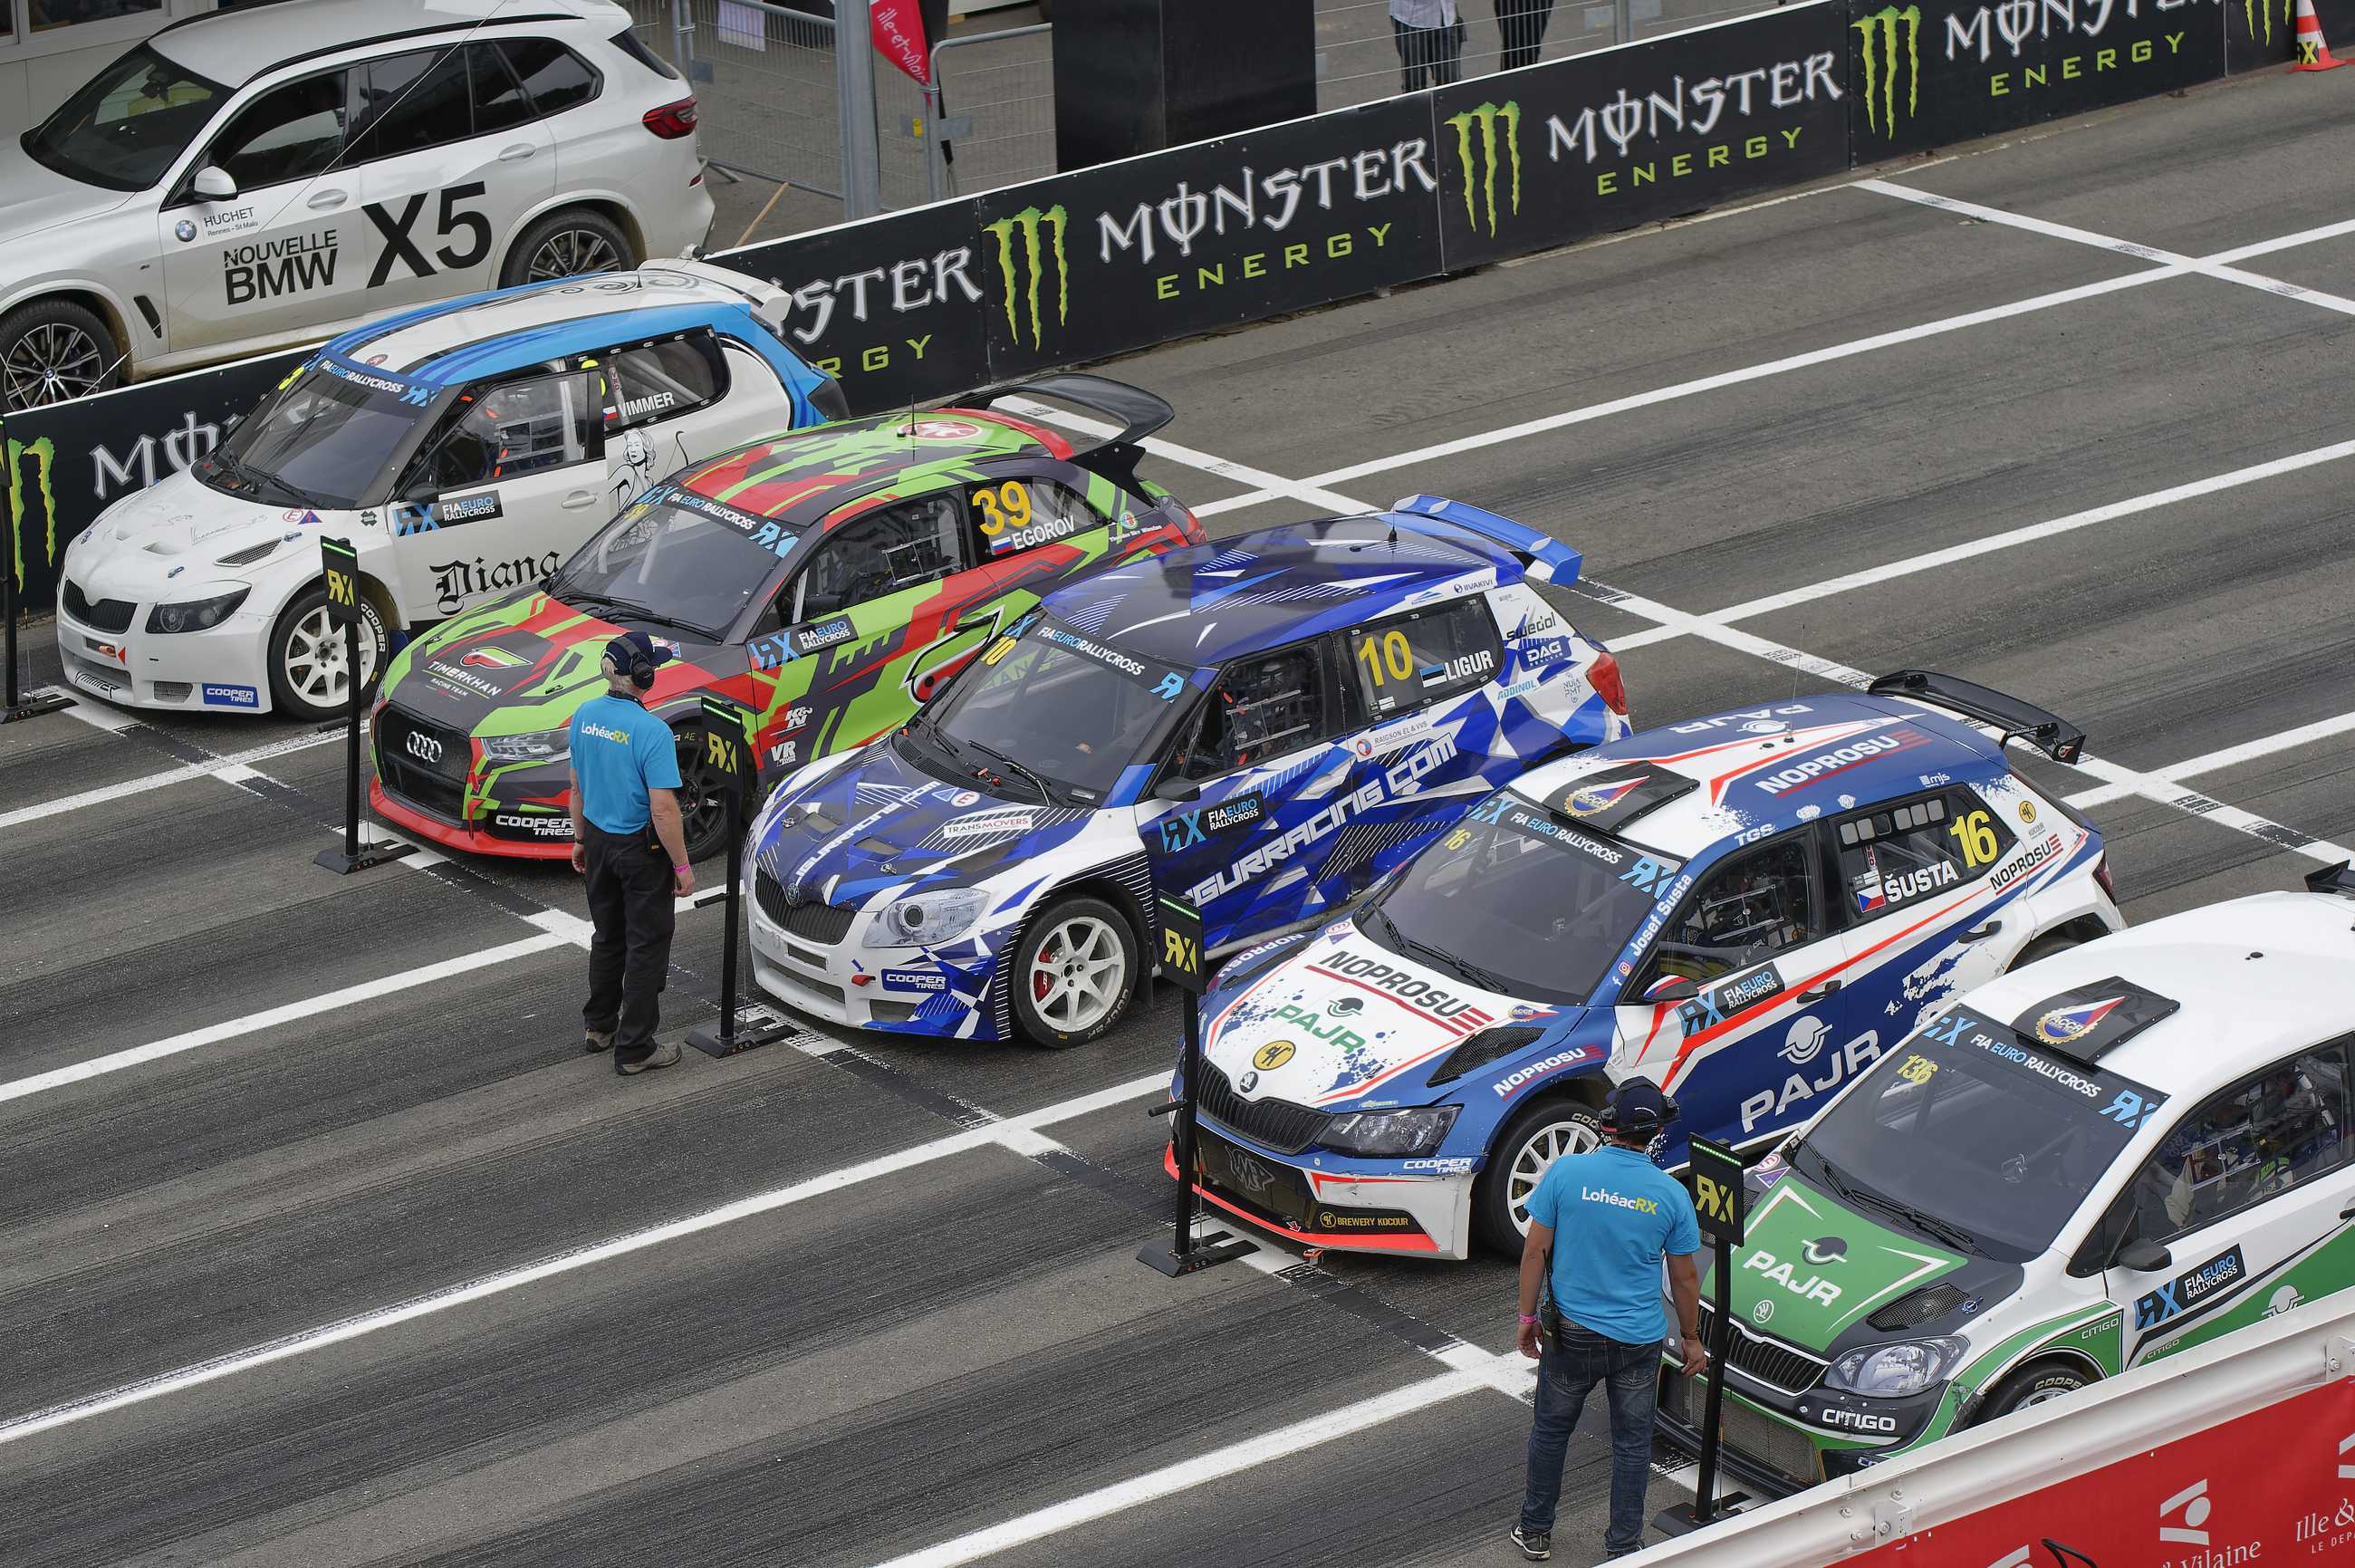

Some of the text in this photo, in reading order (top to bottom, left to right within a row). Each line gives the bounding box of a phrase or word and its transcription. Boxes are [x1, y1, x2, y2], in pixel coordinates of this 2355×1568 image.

[1991, 32, 2185, 96] ENERGY
[1547, 51, 1843, 164] MONSTER
[1598, 127, 1802, 196] ENERGY
[204, 207, 254, 227] HUCHET
[1096, 138, 1437, 264] MONSTER
[225, 229, 338, 268] NOUVELLE
[362, 180, 493, 289] X5
[226, 248, 338, 305] BMW
[1158, 223, 1391, 300] ENERGY
[444, 505, 495, 522] RALLYCROSS
[972, 481, 1032, 536] 39
[1012, 515, 1075, 550] EGOROV
[327, 569, 354, 607] RX
[360, 602, 387, 652] COOPER
[802, 629, 851, 649] RALLYCROSS
[981, 636, 1017, 666] 10
[1358, 630, 1413, 687] 10
[1444, 649, 1495, 681] LIGUR
[1526, 640, 1562, 662] DAG
[207, 688, 254, 697] COOPER
[428, 661, 502, 697] TIMERKHAN
[1497, 680, 1536, 700] ADDINOL
[582, 721, 630, 746] LohéacRX
[708, 731, 737, 775] RX
[1754, 736, 1900, 794] NOPROSU
[495, 814, 574, 829] COOPER
[533, 827, 574, 836] TIRES
[948, 818, 1029, 833] TRANSMOVERS
[1210, 808, 1259, 831] RALLYCROSS
[1735, 823, 1773, 847] TGS
[1444, 829, 1472, 851] 16
[1510, 812, 1622, 864] FIA EURO RALLYCROSS
[1949, 810, 1998, 869] 16
[1884, 860, 1959, 903] ŠUSTA
[1990, 841, 2051, 890] NOPROSU
[1630, 874, 1692, 957] Josef Susta
[1165, 928, 1197, 976] RX
[886, 973, 946, 984] COOPER
[916, 982, 946, 990] TIRES
[1320, 951, 1471, 1018] NOPROSU
[1728, 981, 1778, 1010] RALLYCROSS
[1270, 1005, 1366, 1054] PAJR
[1493, 1047, 1587, 1097] NOPROSU
[1741, 1029, 1881, 1133] PAJR
[1897, 1055, 1938, 1085] 136
[1970, 1034, 2101, 1098] FIA EURO RALLYCROSS
[1403, 1158, 1472, 1169] COOPER
[1582, 1187, 1658, 1217] LohéacRX
[1696, 1174, 1734, 1226] RX
[1338, 1217, 1408, 1227] BREWERY KOCOUR
[1743, 1250, 1842, 1307] PAJR
[2187, 1265, 2238, 1299] RALLYCROSS
[2081, 1317, 2120, 1340] CITIGO
[2035, 1377, 2084, 1391] COOPE
[1822, 1408, 1896, 1432] CITIGO
[2296, 1513, 2330, 1542] Ille
[2312, 1531, 2355, 1554] LE DEP
